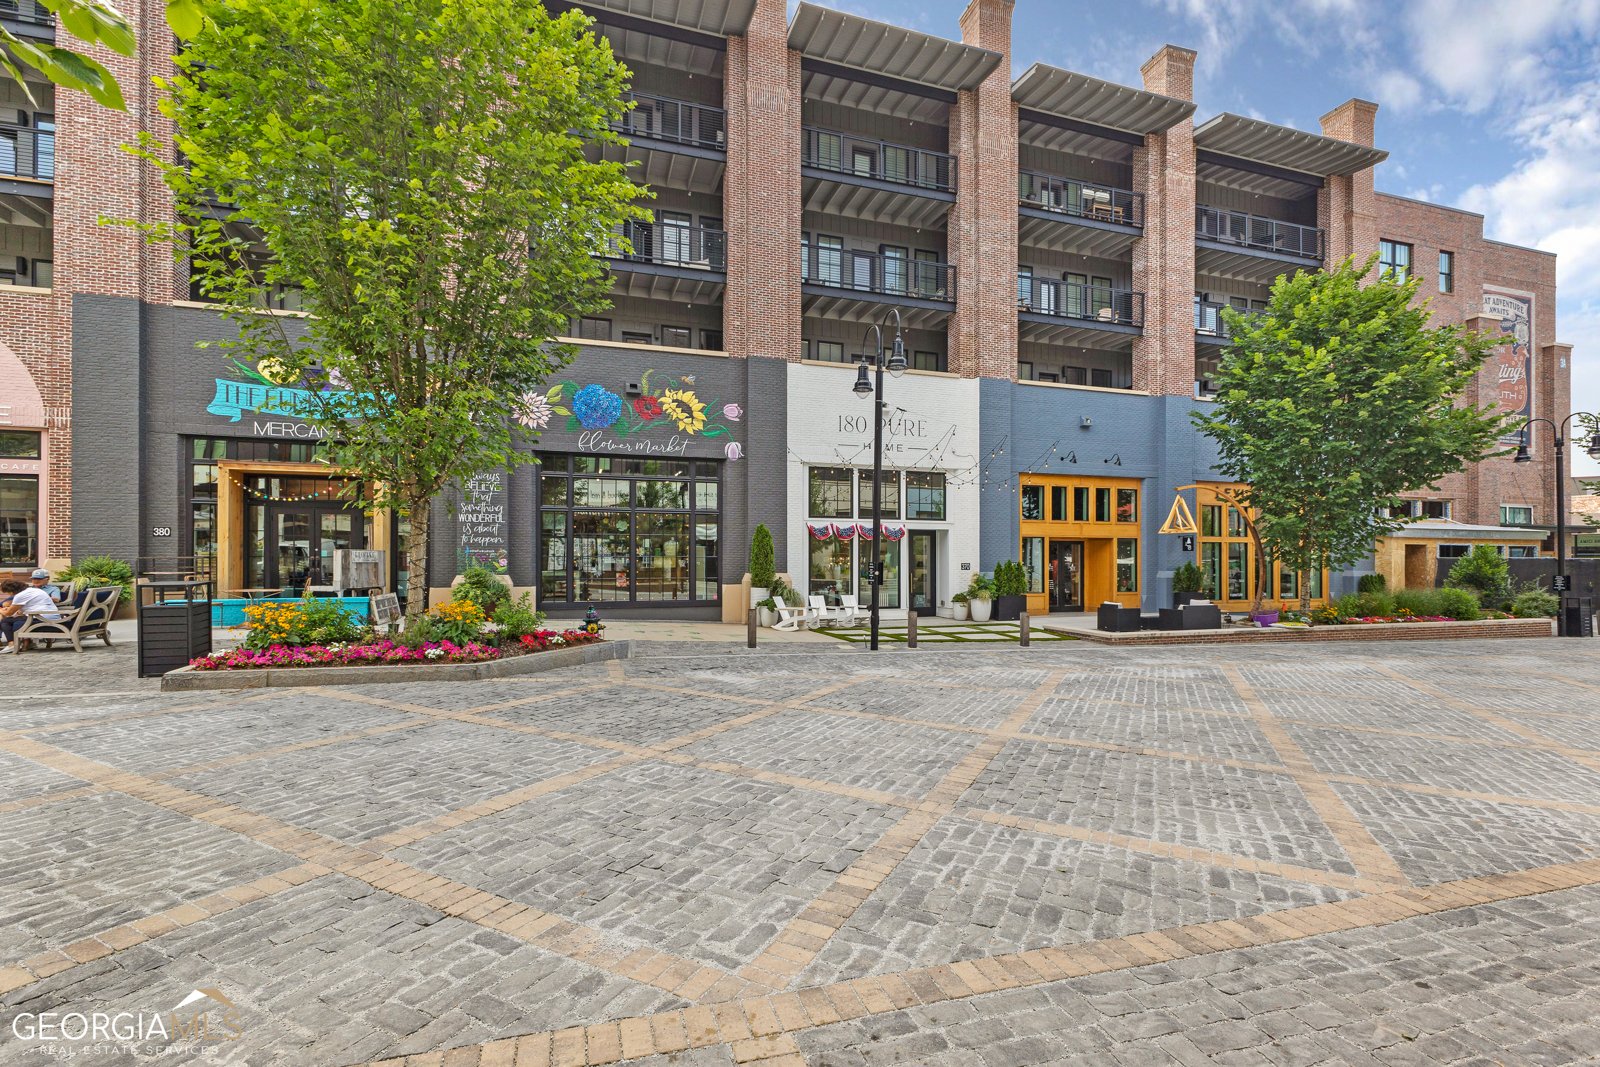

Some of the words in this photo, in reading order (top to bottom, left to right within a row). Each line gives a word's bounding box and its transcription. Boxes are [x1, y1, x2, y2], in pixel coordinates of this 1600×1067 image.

[1489, 307, 1509, 315] AWAITS
[1492, 297, 1524, 314] ADVENTURE
[220, 382, 261, 407] THE
[838, 414, 867, 433] 180
[881, 417, 927, 437] PURE
[863, 442, 904, 452] HME
[471, 489, 500, 504] that
[458, 513, 506, 522] WONDERFUL
[153, 528, 170, 536] 380
[463, 523, 472, 535] is
[473, 523, 501, 536] about
[470, 534, 504, 546] happen
